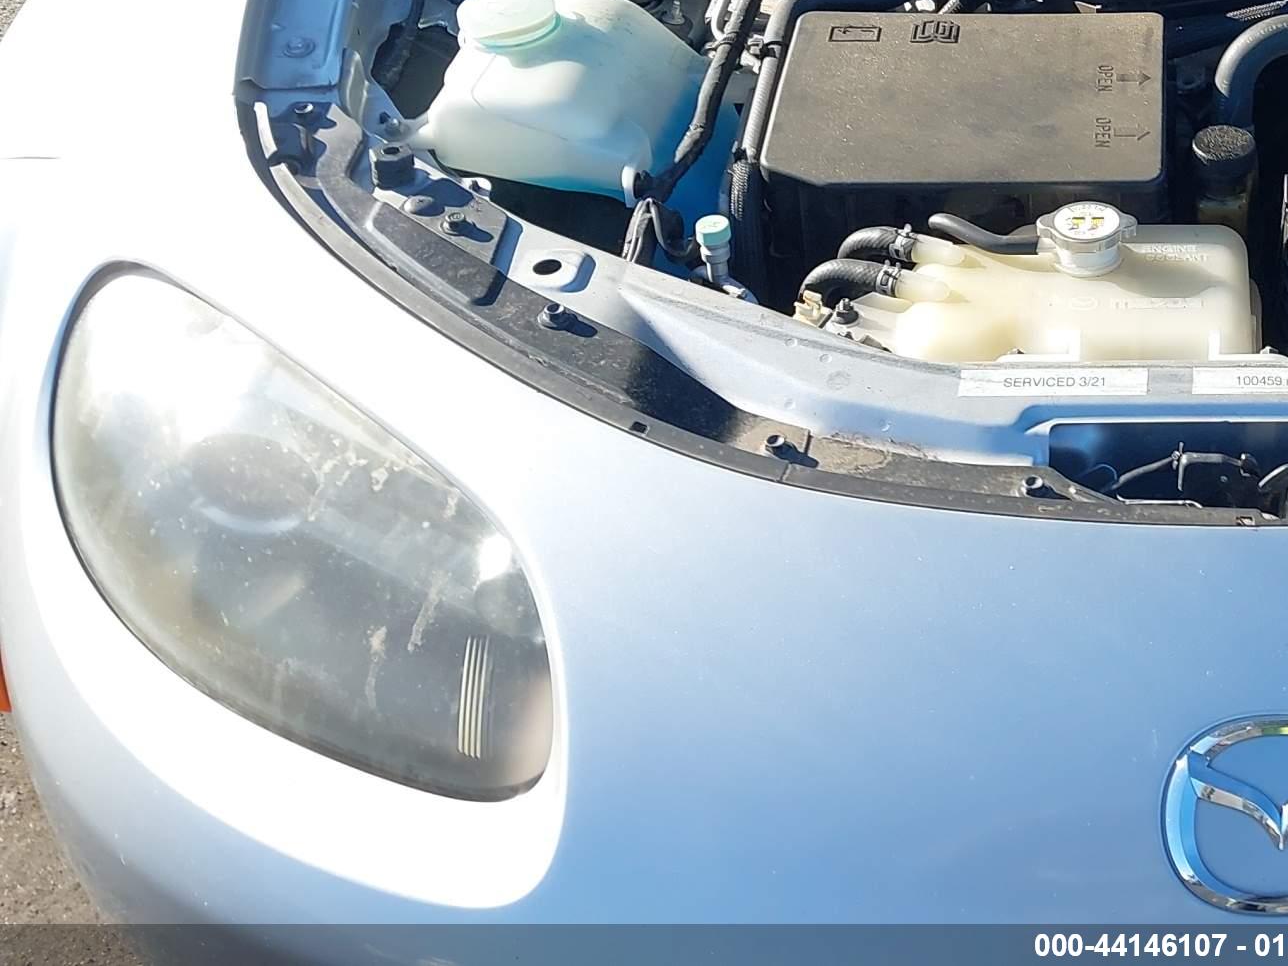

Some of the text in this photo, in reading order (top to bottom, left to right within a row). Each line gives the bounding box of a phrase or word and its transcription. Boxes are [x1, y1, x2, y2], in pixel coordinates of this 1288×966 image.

[1097, 65, 1114, 92] OPEN
[1095, 117, 1112, 148] OPEN
[1003, 376, 1105, 388] SERVICED 3/21
[1236, 375, 1283, 386] 100459
